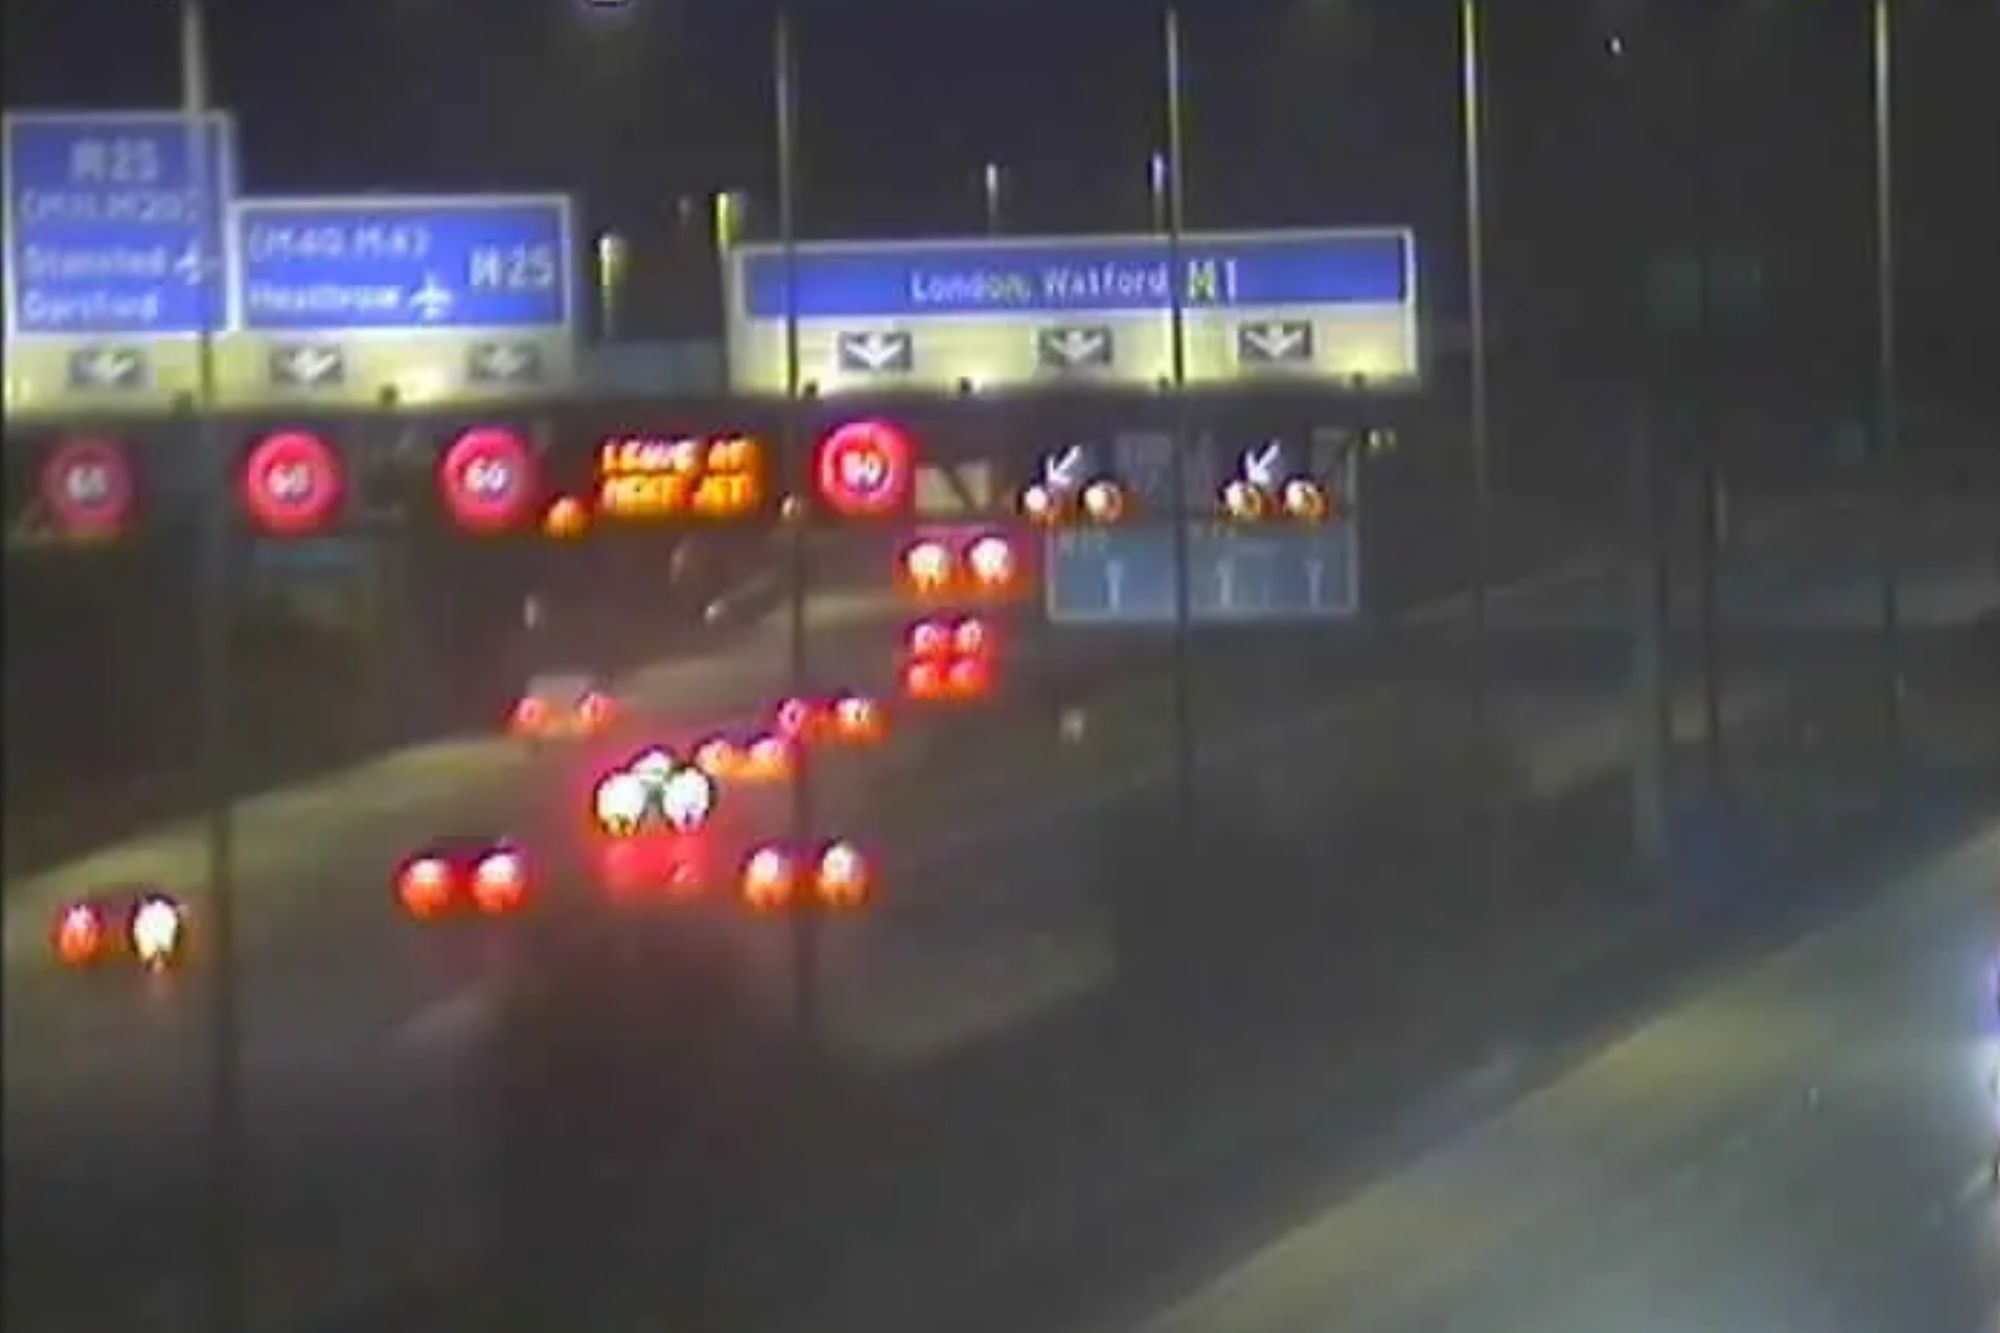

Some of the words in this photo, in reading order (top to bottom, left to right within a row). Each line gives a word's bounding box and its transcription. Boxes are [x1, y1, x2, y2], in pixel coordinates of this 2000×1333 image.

[71, 139, 158, 182] M25
[469, 245, 555, 287] M25
[911, 268, 1033, 302] London,
[1045, 263, 1169, 298] Watford
[1187, 258, 1238, 300] M1
